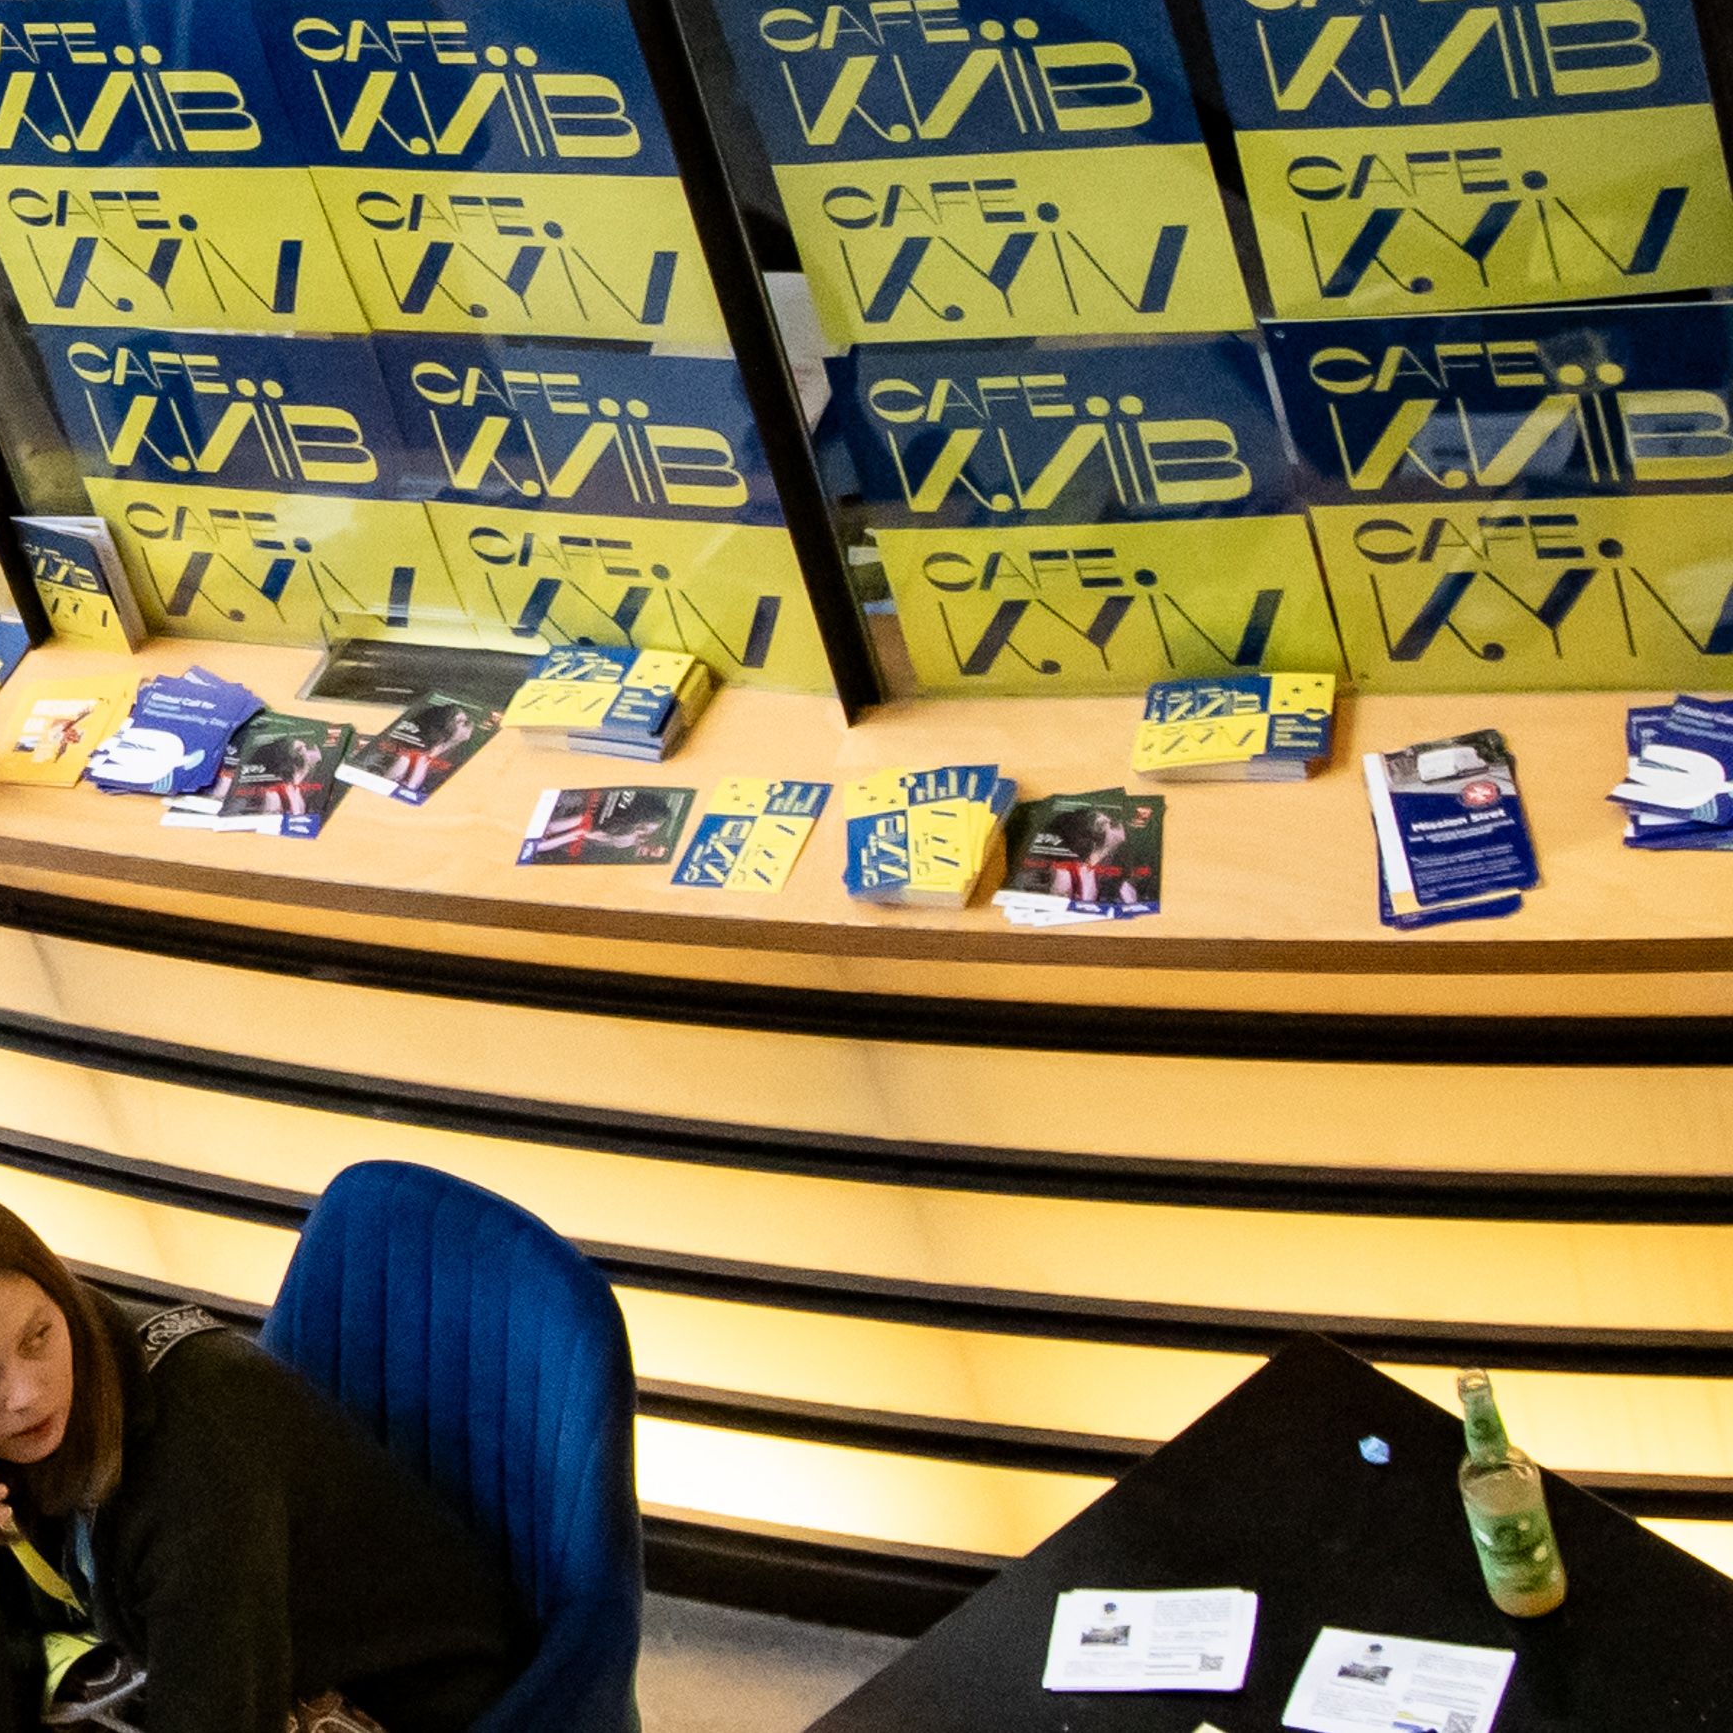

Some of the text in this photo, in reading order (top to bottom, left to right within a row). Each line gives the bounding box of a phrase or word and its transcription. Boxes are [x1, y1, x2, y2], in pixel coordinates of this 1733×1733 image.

[292, 17, 477, 66] CAFE
[1286, 146, 1510, 201] CAFE
[8, 188, 183, 232] CAFE
[355, 191, 535, 238] CAFE
[821, 176, 1027, 230] CAFE
[67, 341, 230, 393] CAFE
[410, 361, 591, 416] CAFE
[1308, 340, 1546, 395] CAFE
[869, 372, 1079, 425] CAFE
[125, 500, 297, 549] CAFE
[1352, 513, 1586, 565] CAFE
[466, 525, 641, 582] CAFE
[922, 548, 1130, 594] CAFE
